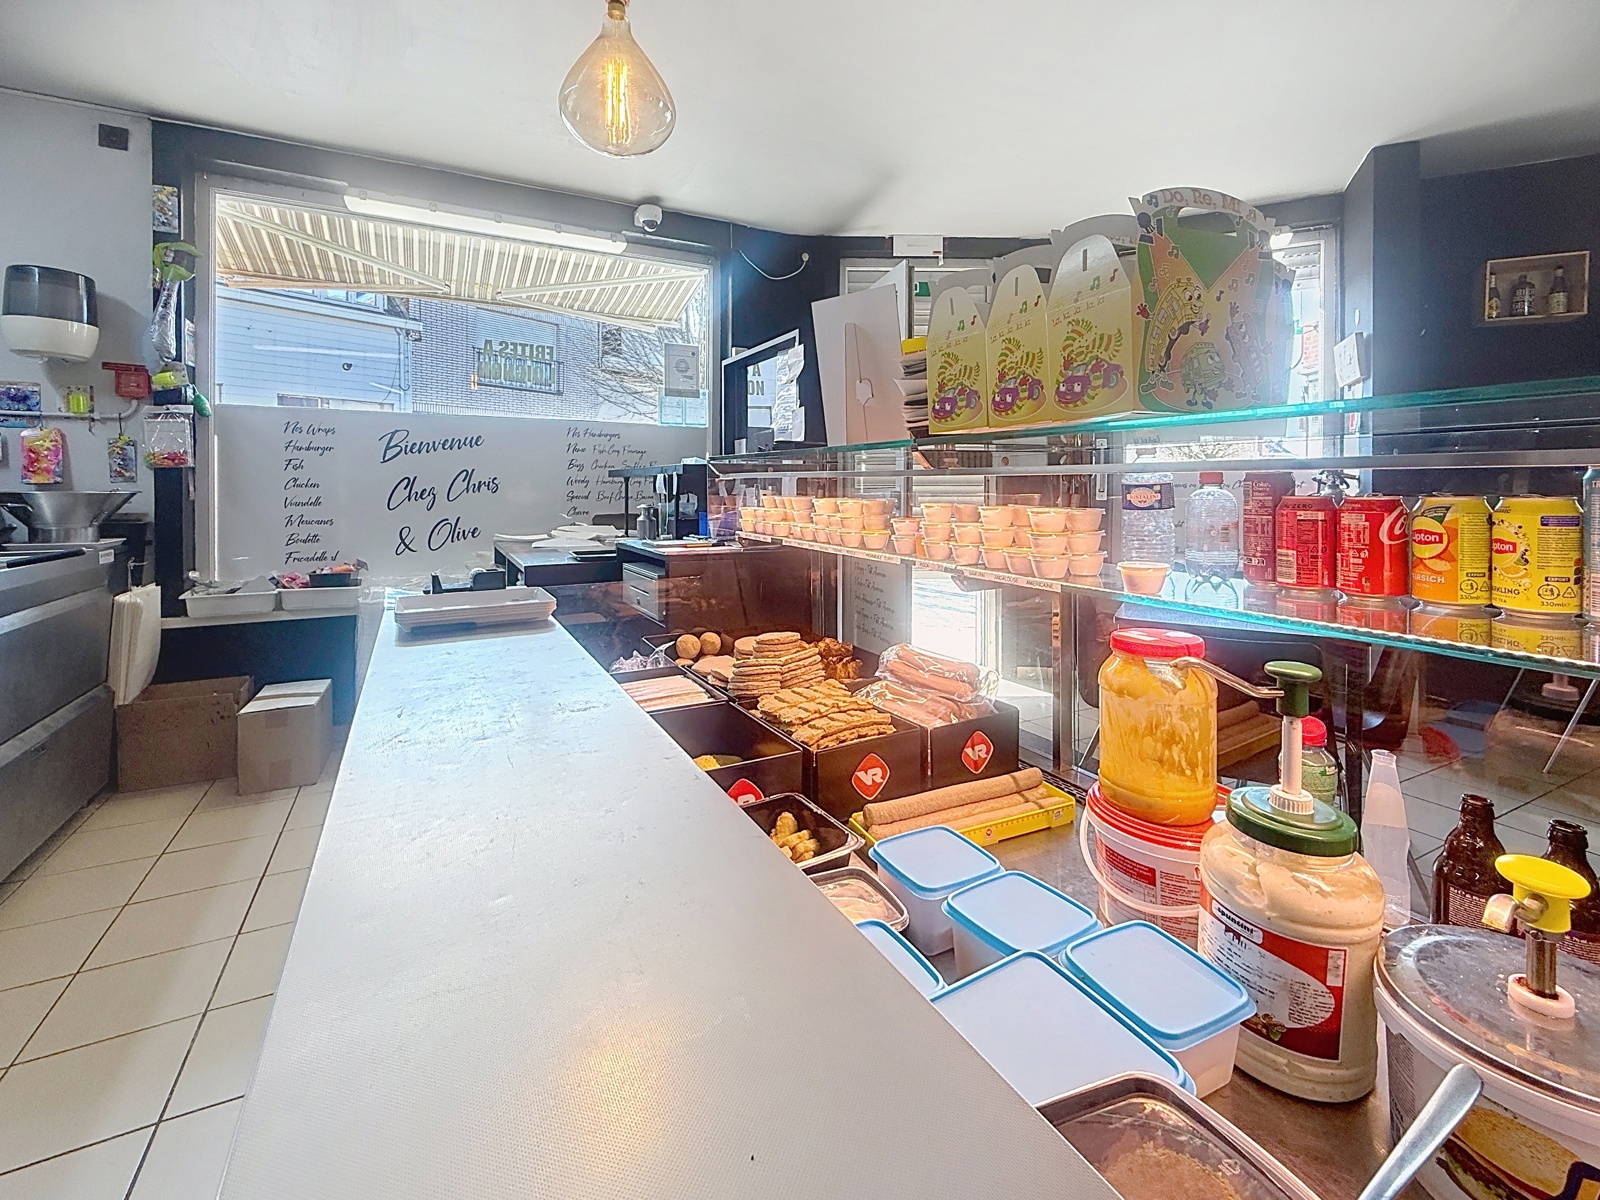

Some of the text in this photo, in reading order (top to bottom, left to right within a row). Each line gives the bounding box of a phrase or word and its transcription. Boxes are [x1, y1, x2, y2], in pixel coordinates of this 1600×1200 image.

[284, 439, 335, 456] Hamburger
[378, 429, 485, 464] Bienvenue
[284, 458, 304, 471] Fish
[284, 477, 320, 490] Chicken
[387, 468, 501, 511] Chez Chris
[395, 516, 482, 556] & Olive
